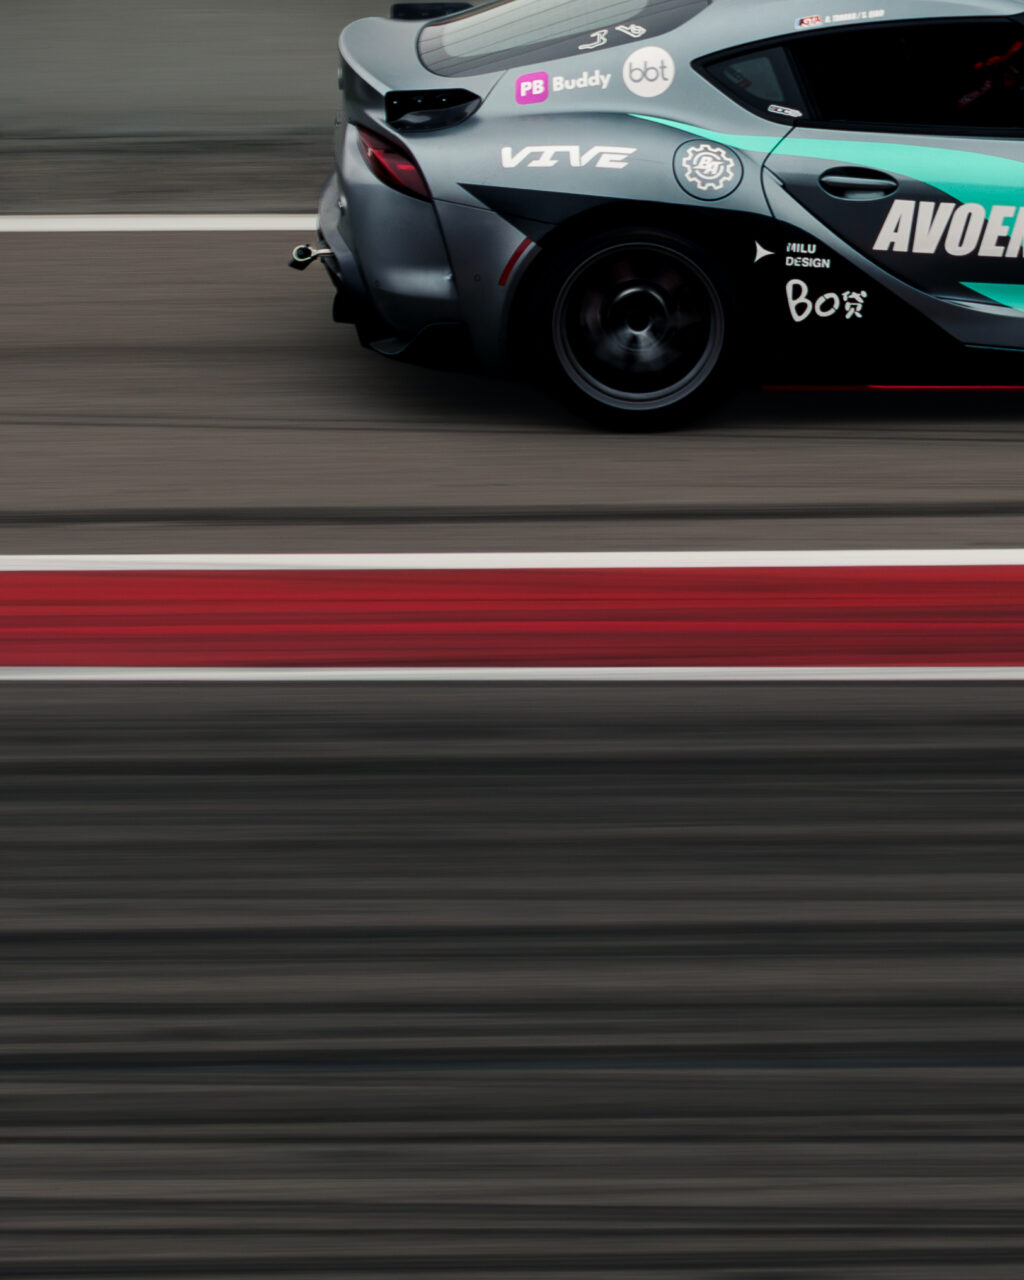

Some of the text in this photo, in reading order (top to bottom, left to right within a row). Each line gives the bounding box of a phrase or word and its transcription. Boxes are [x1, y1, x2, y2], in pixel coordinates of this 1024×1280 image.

[520, 69, 612, 96] PB Buddy
[629, 60, 669, 83] bbt
[501, 145, 637, 168] VIVE
[786, 242, 816, 254] MILU
[785, 256, 831, 268] DESIGN
